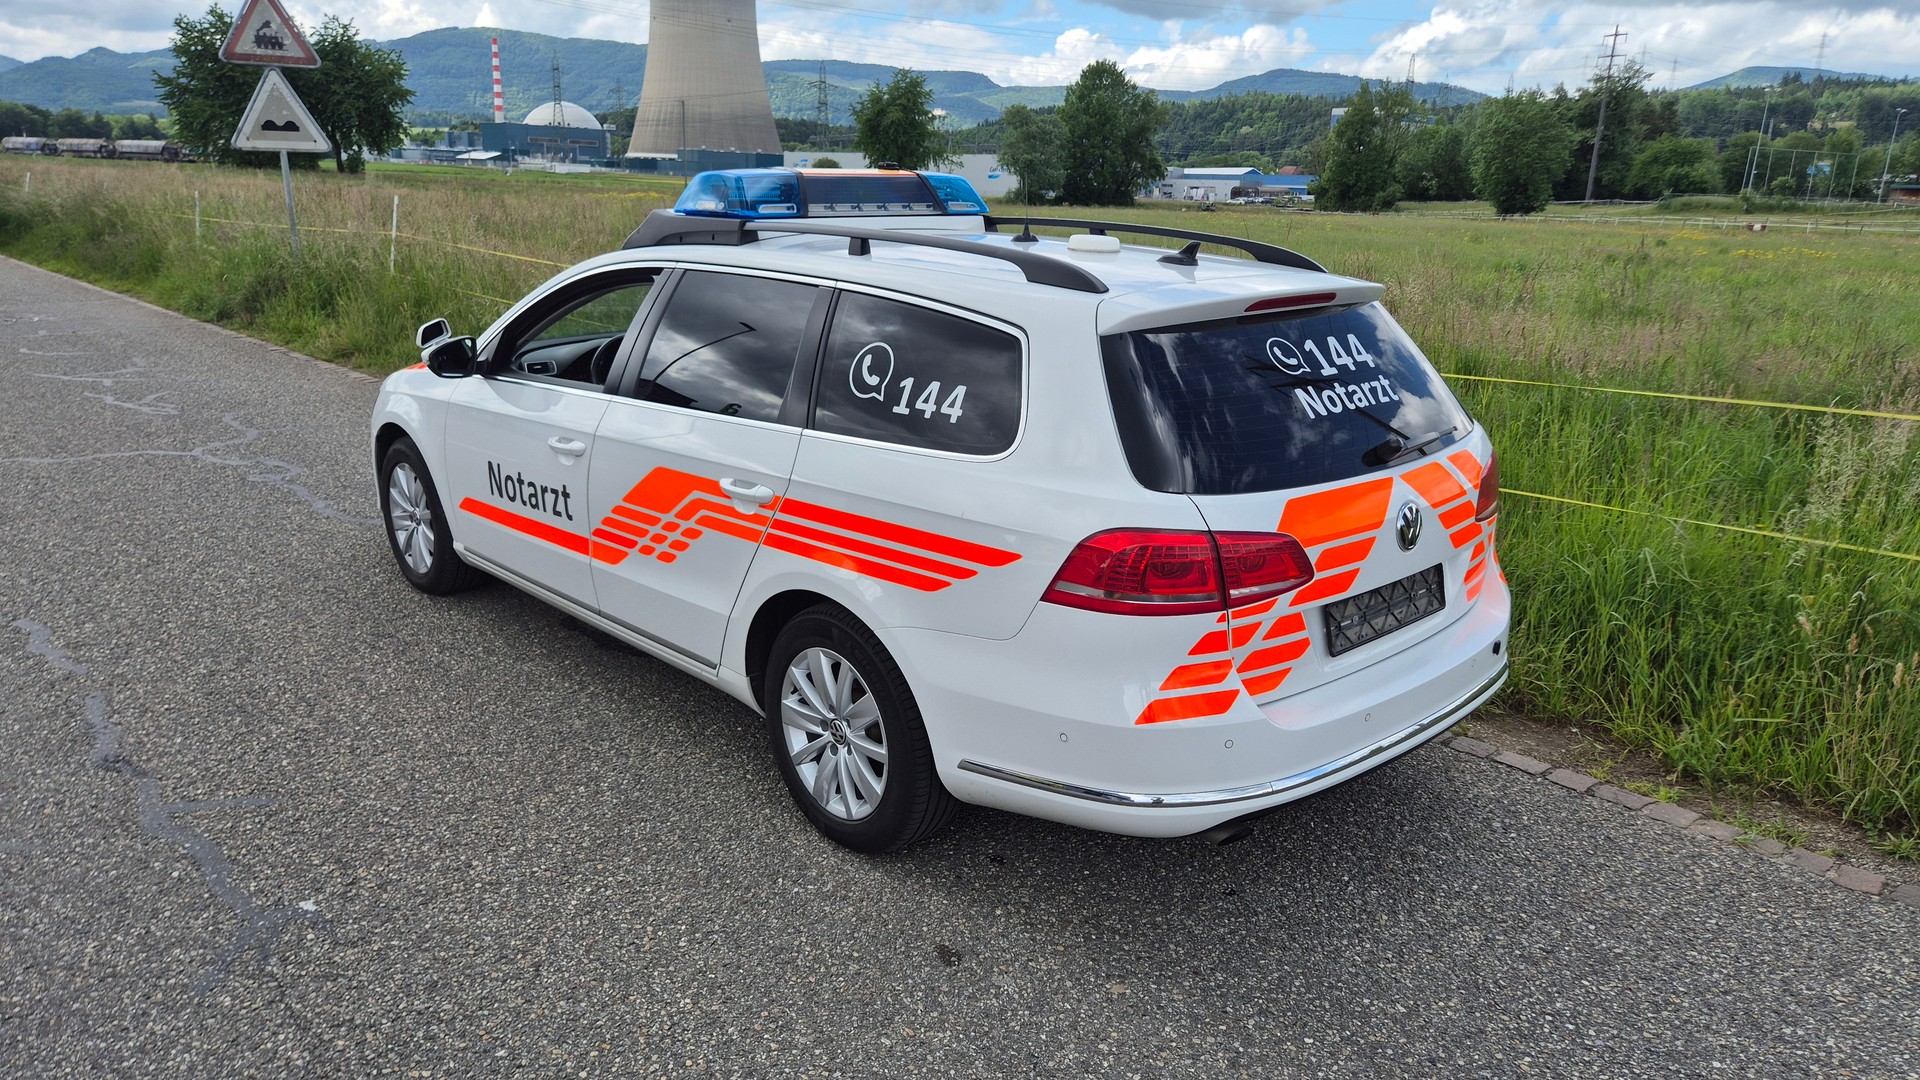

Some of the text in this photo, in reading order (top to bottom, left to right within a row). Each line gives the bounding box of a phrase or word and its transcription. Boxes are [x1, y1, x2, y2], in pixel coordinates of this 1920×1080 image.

[1304, 334, 1375, 376] 144
[892, 377, 967, 423] 144
[1294, 375, 1399, 419] Notarzt
[488, 461, 573, 521] Notarzt
[1397, 503, 1421, 551] VW
[831, 719, 846, 744] VW
